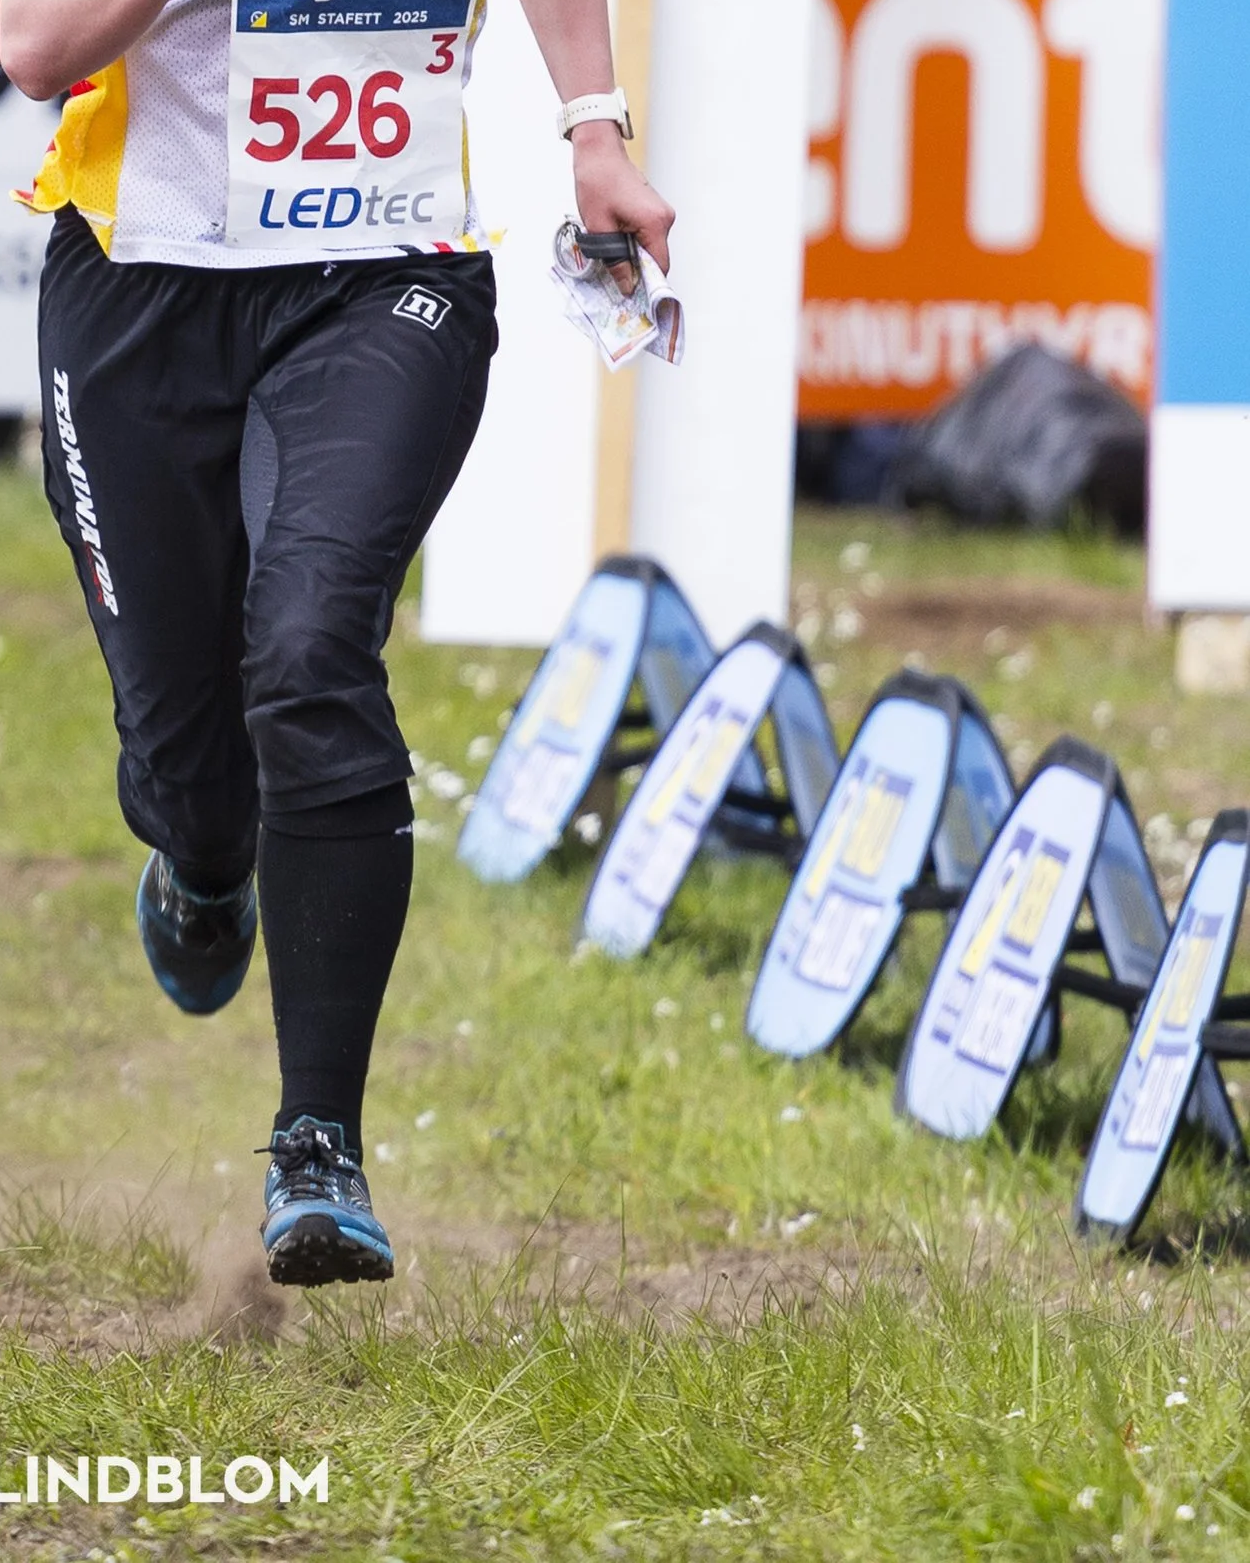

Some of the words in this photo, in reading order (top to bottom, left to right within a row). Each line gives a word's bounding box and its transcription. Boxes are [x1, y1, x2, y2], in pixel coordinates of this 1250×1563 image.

[289, 12, 310, 26] SM
[317, 12, 382, 25] STAFETT
[393, 11, 428, 25] 2025
[425, 33, 459, 74] 3
[245, 70, 411, 162] 526
